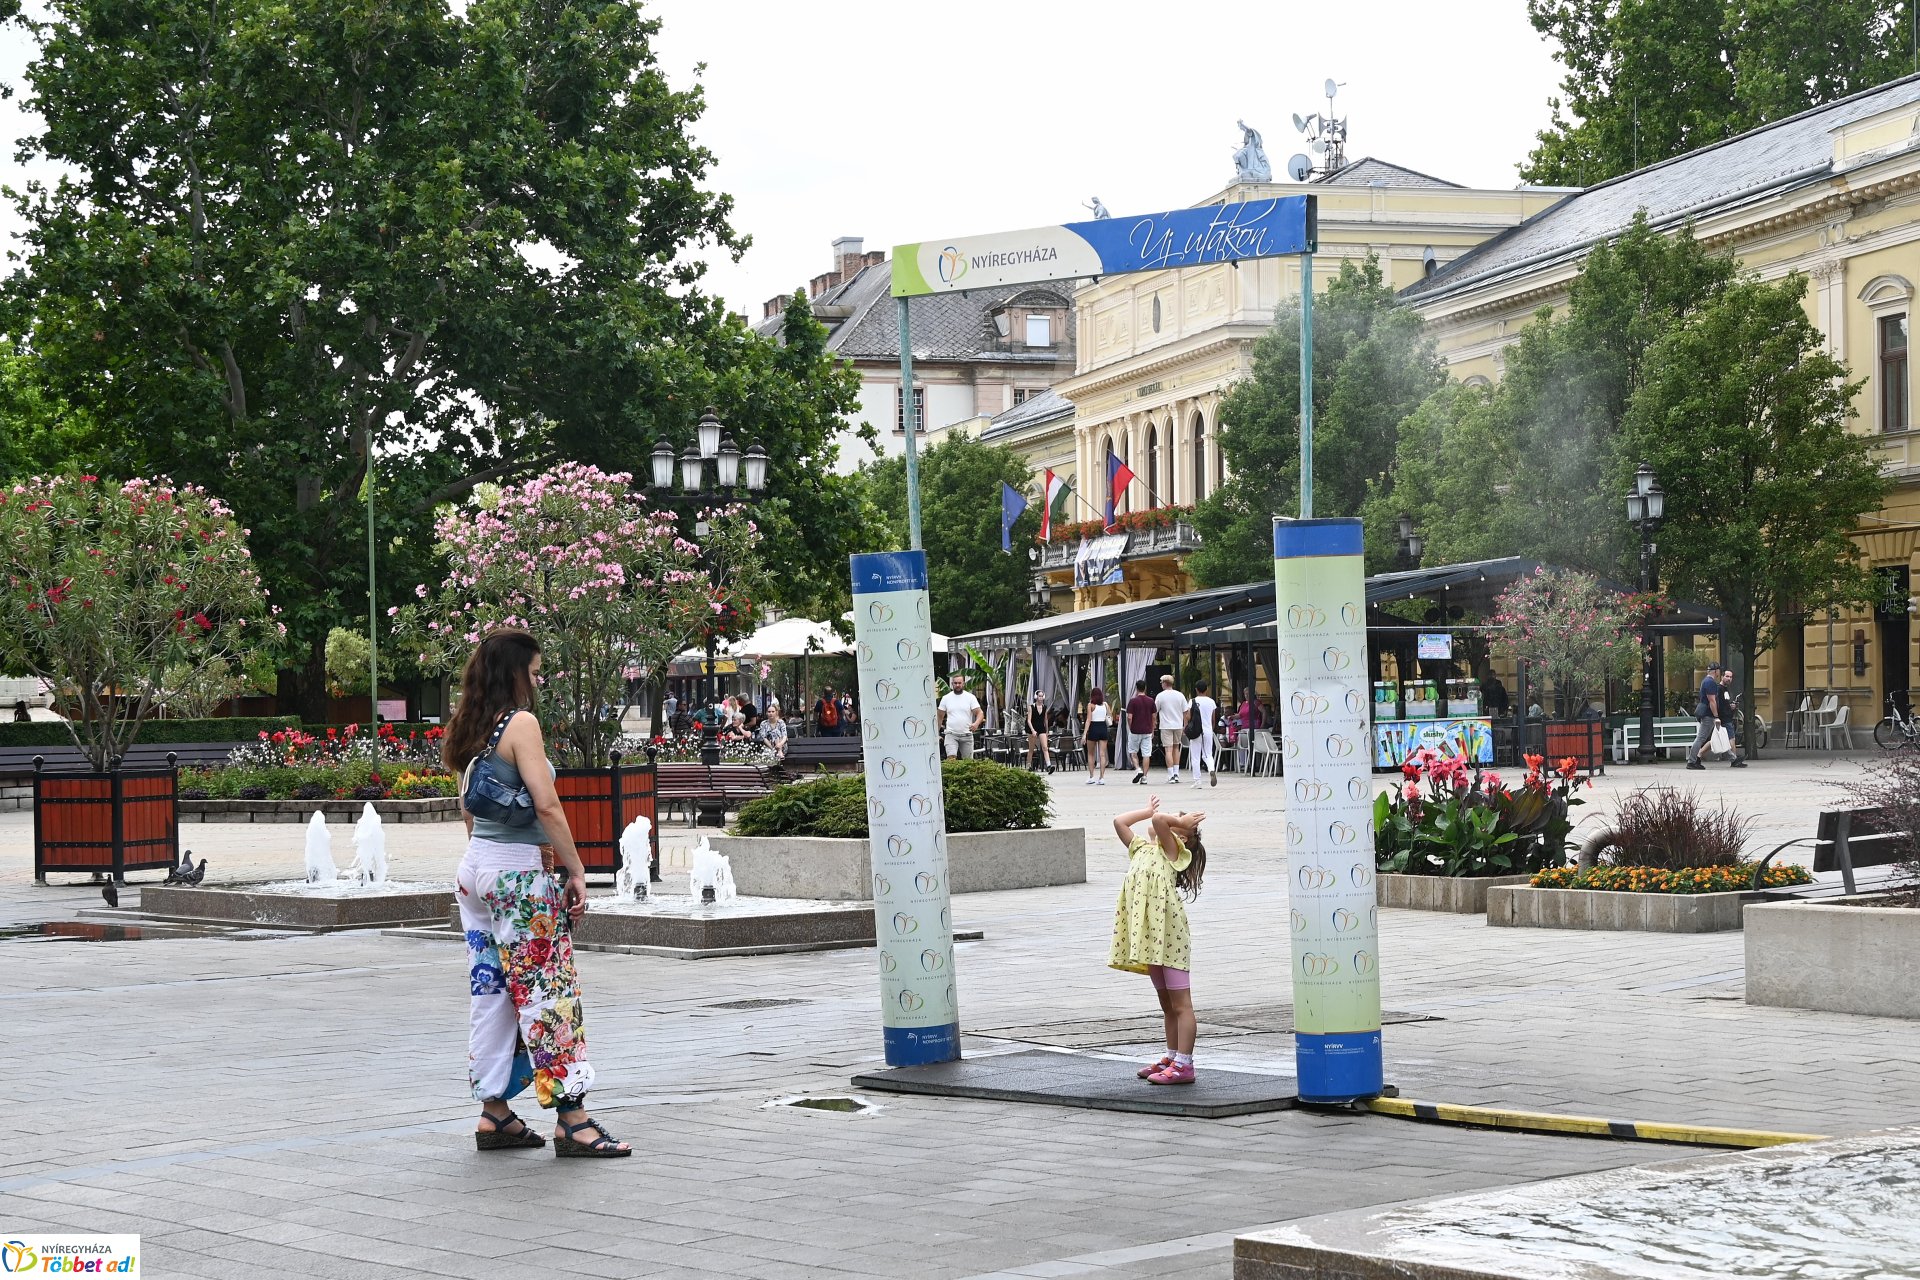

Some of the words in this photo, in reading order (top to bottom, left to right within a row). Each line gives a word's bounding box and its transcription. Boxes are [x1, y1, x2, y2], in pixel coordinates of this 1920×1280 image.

[1130, 210, 1183, 270] Új
[1184, 197, 1274, 262] utakon
[971, 245, 1058, 270] NYÍREGYHÁZA
[1422, 729, 1445, 739] slushy
